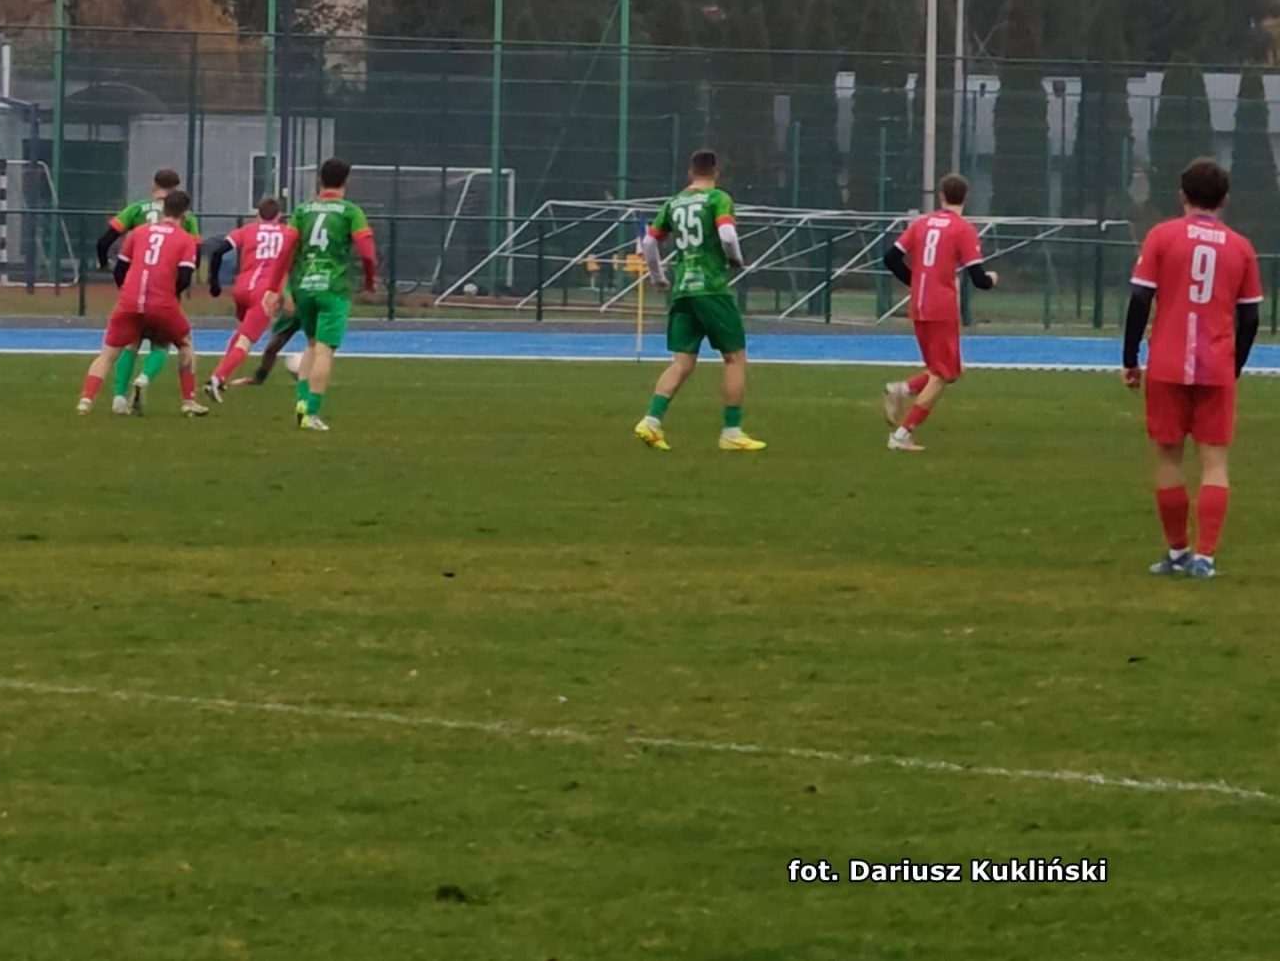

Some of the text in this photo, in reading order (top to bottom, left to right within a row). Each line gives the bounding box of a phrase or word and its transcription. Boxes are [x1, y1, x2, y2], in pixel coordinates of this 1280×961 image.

[255, 231, 284, 260] 20
[309, 213, 329, 252] 4
[672, 203, 703, 250] 35
[144, 233, 165, 266] 3
[923, 228, 941, 267] 8
[1189, 244, 1217, 304] 9
